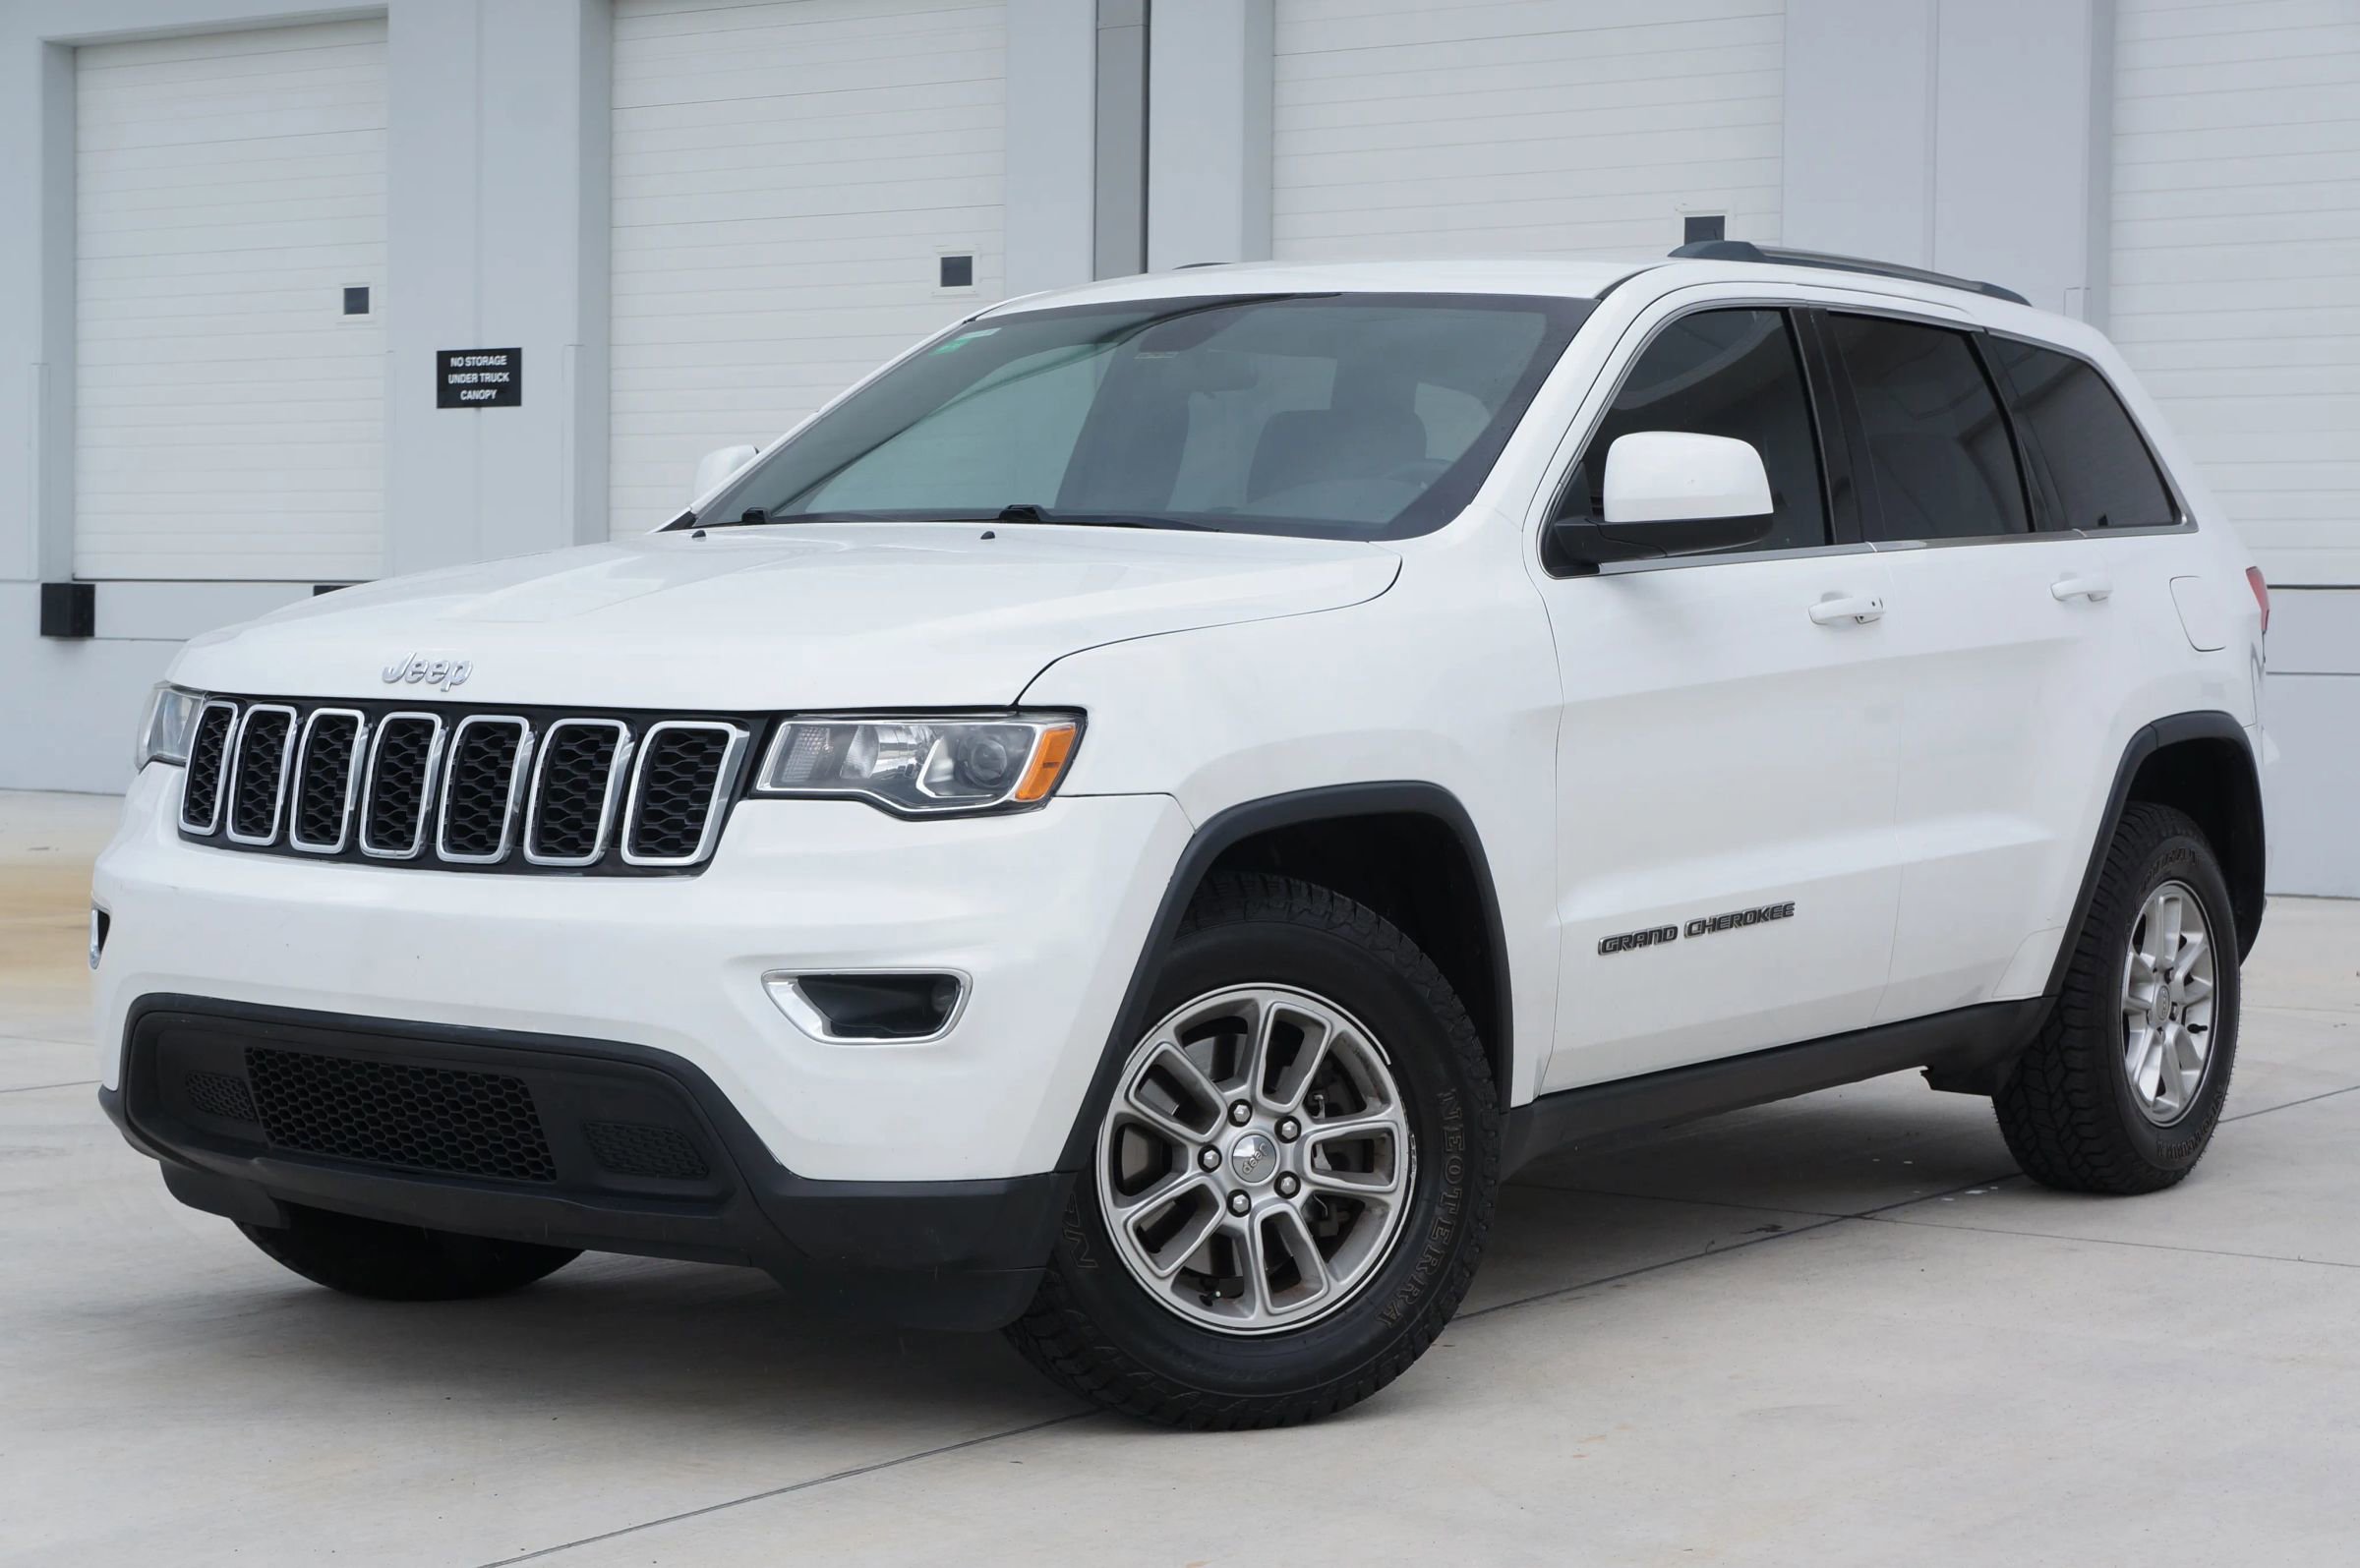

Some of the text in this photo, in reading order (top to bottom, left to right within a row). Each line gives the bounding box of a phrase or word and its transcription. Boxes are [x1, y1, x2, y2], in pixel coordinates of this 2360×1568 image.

[450, 355, 507, 367] NO STORAGE
[447, 372, 510, 384] UNDER TRUCK
[460, 389, 498, 400] CANOPY
[382, 652, 473, 692] Jeep
[1598, 900, 1796, 956] GRAND CHEROKEE
[1378, 1087, 1465, 1328] NEOTERRA
